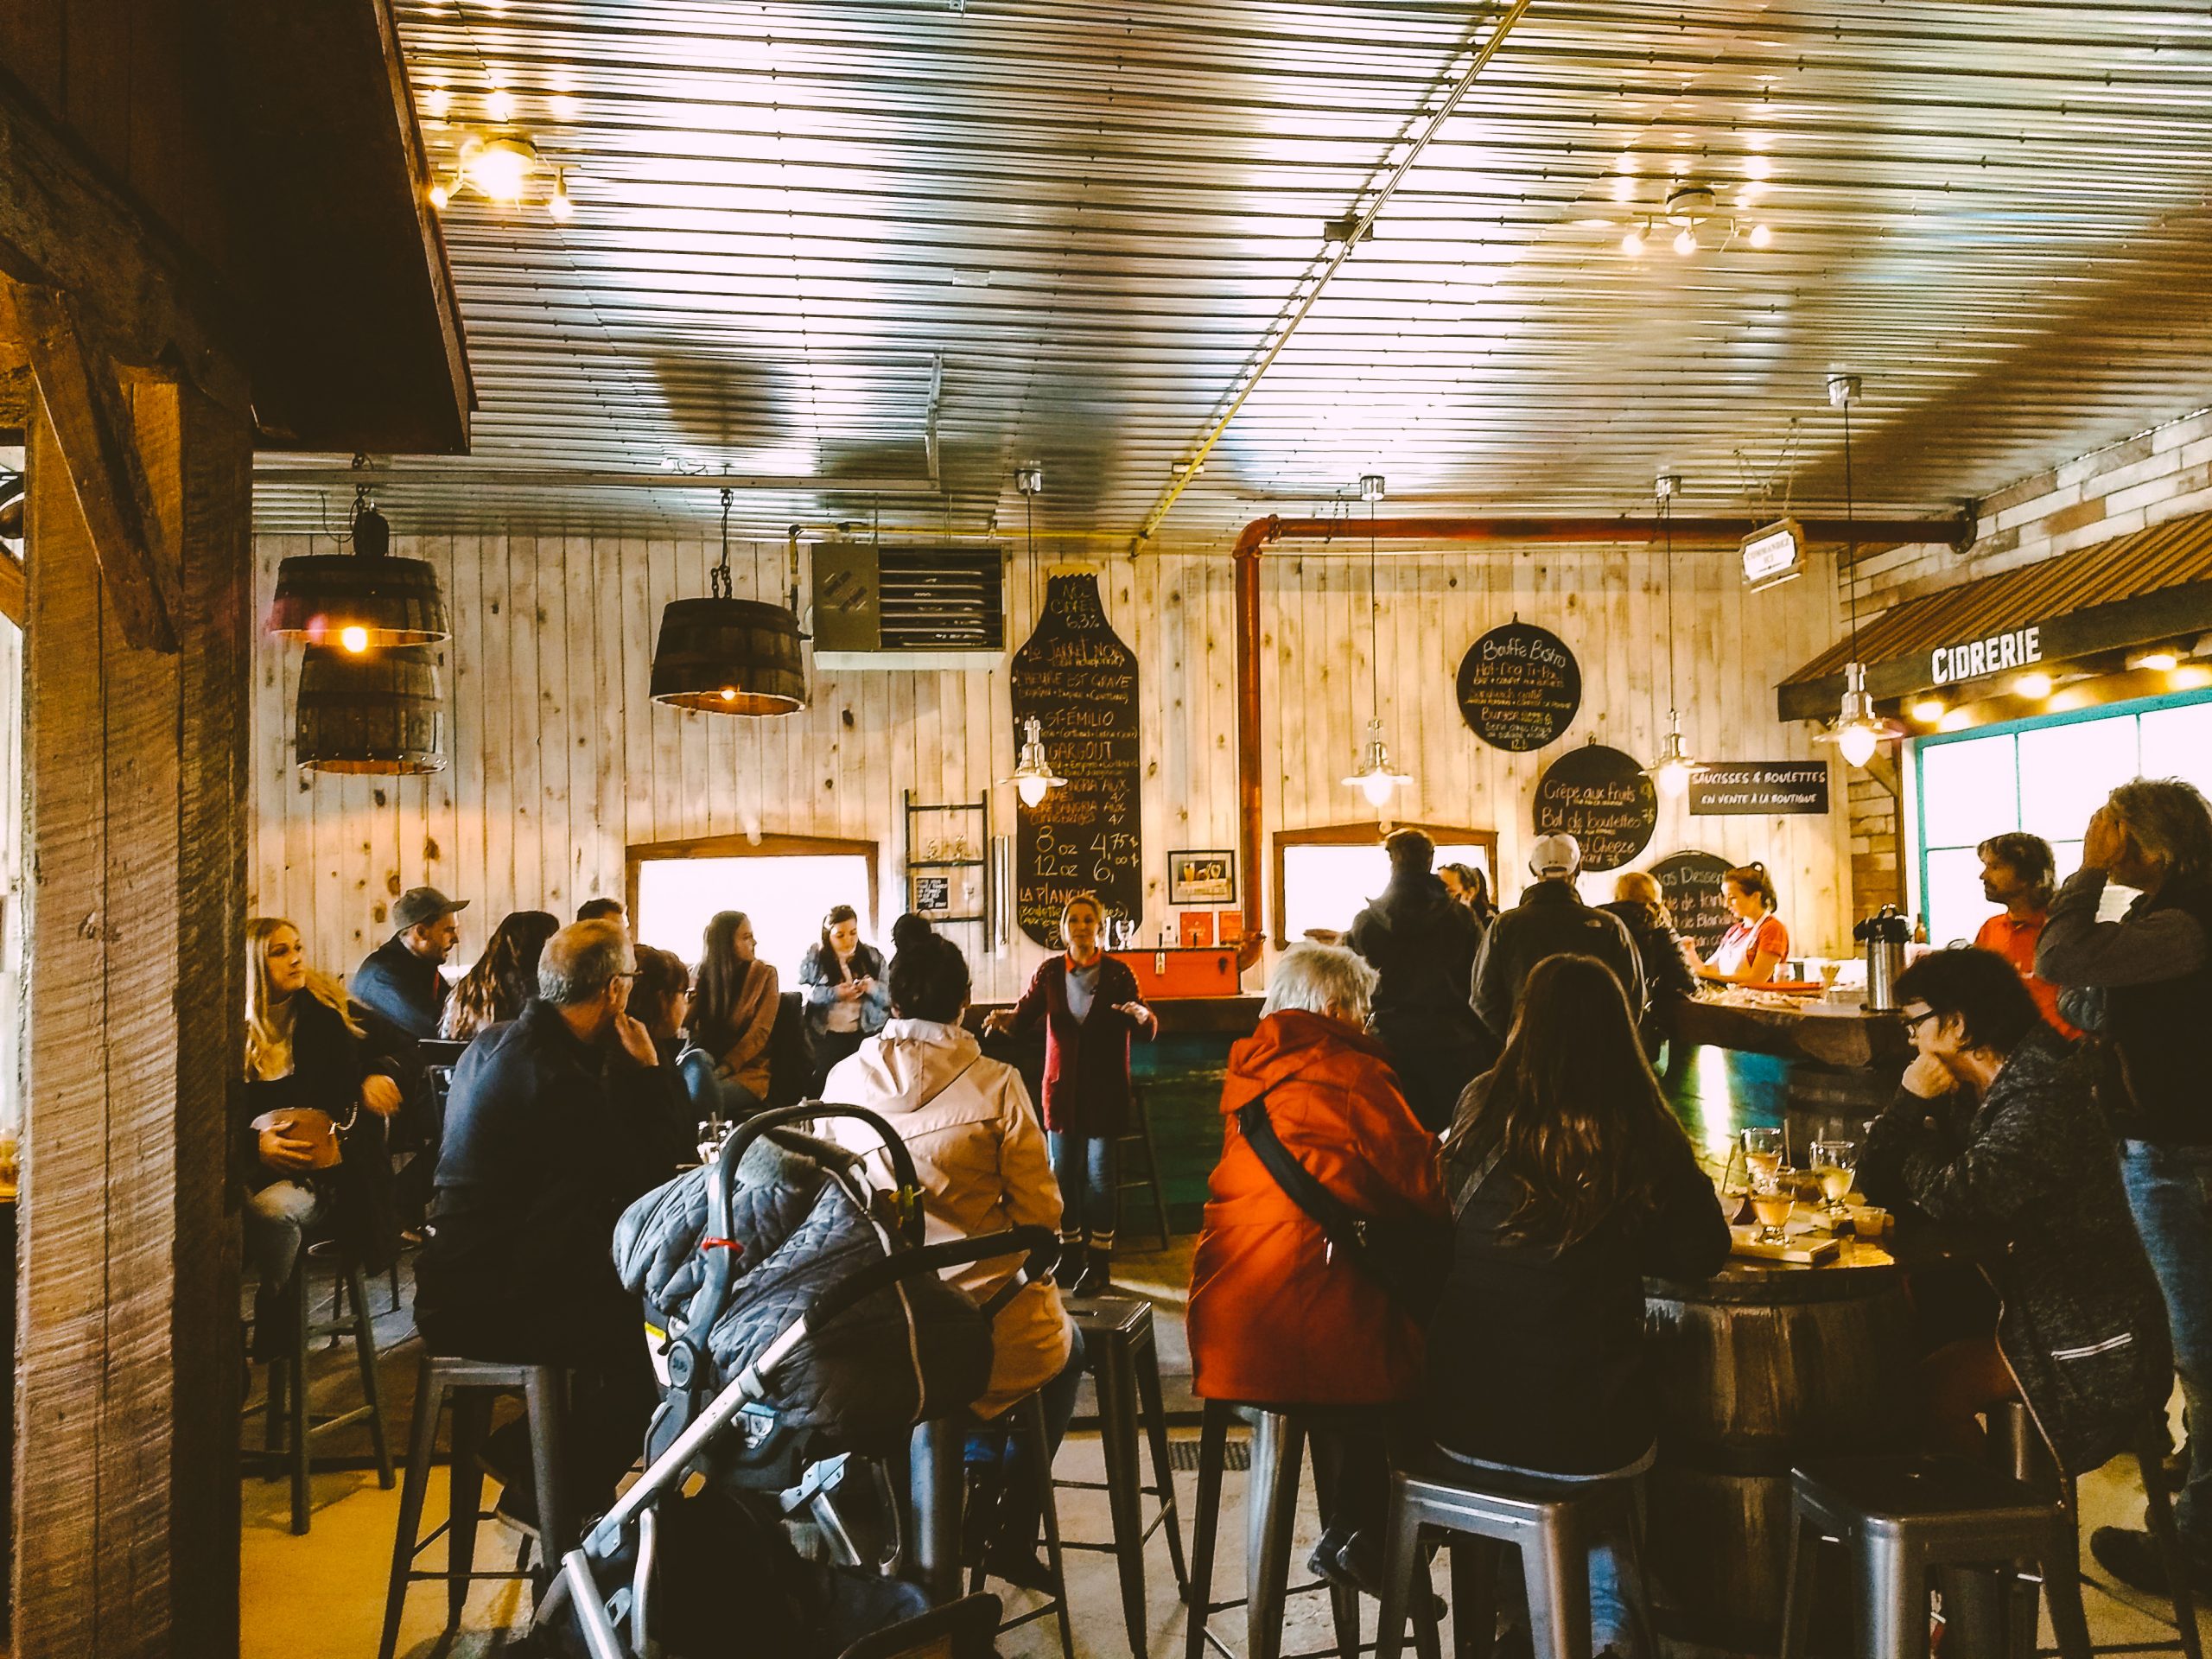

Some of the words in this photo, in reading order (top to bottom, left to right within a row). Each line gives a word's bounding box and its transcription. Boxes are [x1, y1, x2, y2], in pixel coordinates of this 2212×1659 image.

[1483, 637, 1528, 661] Bouffe
[1529, 639, 1567, 668] Bistro
[1931, 626, 2042, 684] CIDRERIE
[1066, 672, 1089, 687] EST
[1091, 673, 1133, 689] GRAVE
[1048, 741, 1113, 760] GARGOUT
[1692, 772, 1751, 785] SAUCISSES
[1764, 770, 1827, 784] BOULETTES
[1544, 779, 1581, 807] Crêpe
[1583, 786, 1605, 800] aux
[1608, 780, 1636, 803] fruits
[1700, 793, 1716, 804] EN
[1718, 793, 1750, 804] VENTE
[1759, 793, 1770, 804] LA
[1771, 793, 1818, 804] BOUTIQUE
[1541, 806, 1563, 828] Bol
[1567, 810, 1583, 830] de
[1586, 810, 1642, 829] boulettes
[1036, 824, 1055, 854] 8
[1058, 844, 1078, 855] oz
[1592, 836, 1637, 855] Cheeze
[1033, 855, 1058, 876] 12
[1020, 887, 1033, 902] LA
